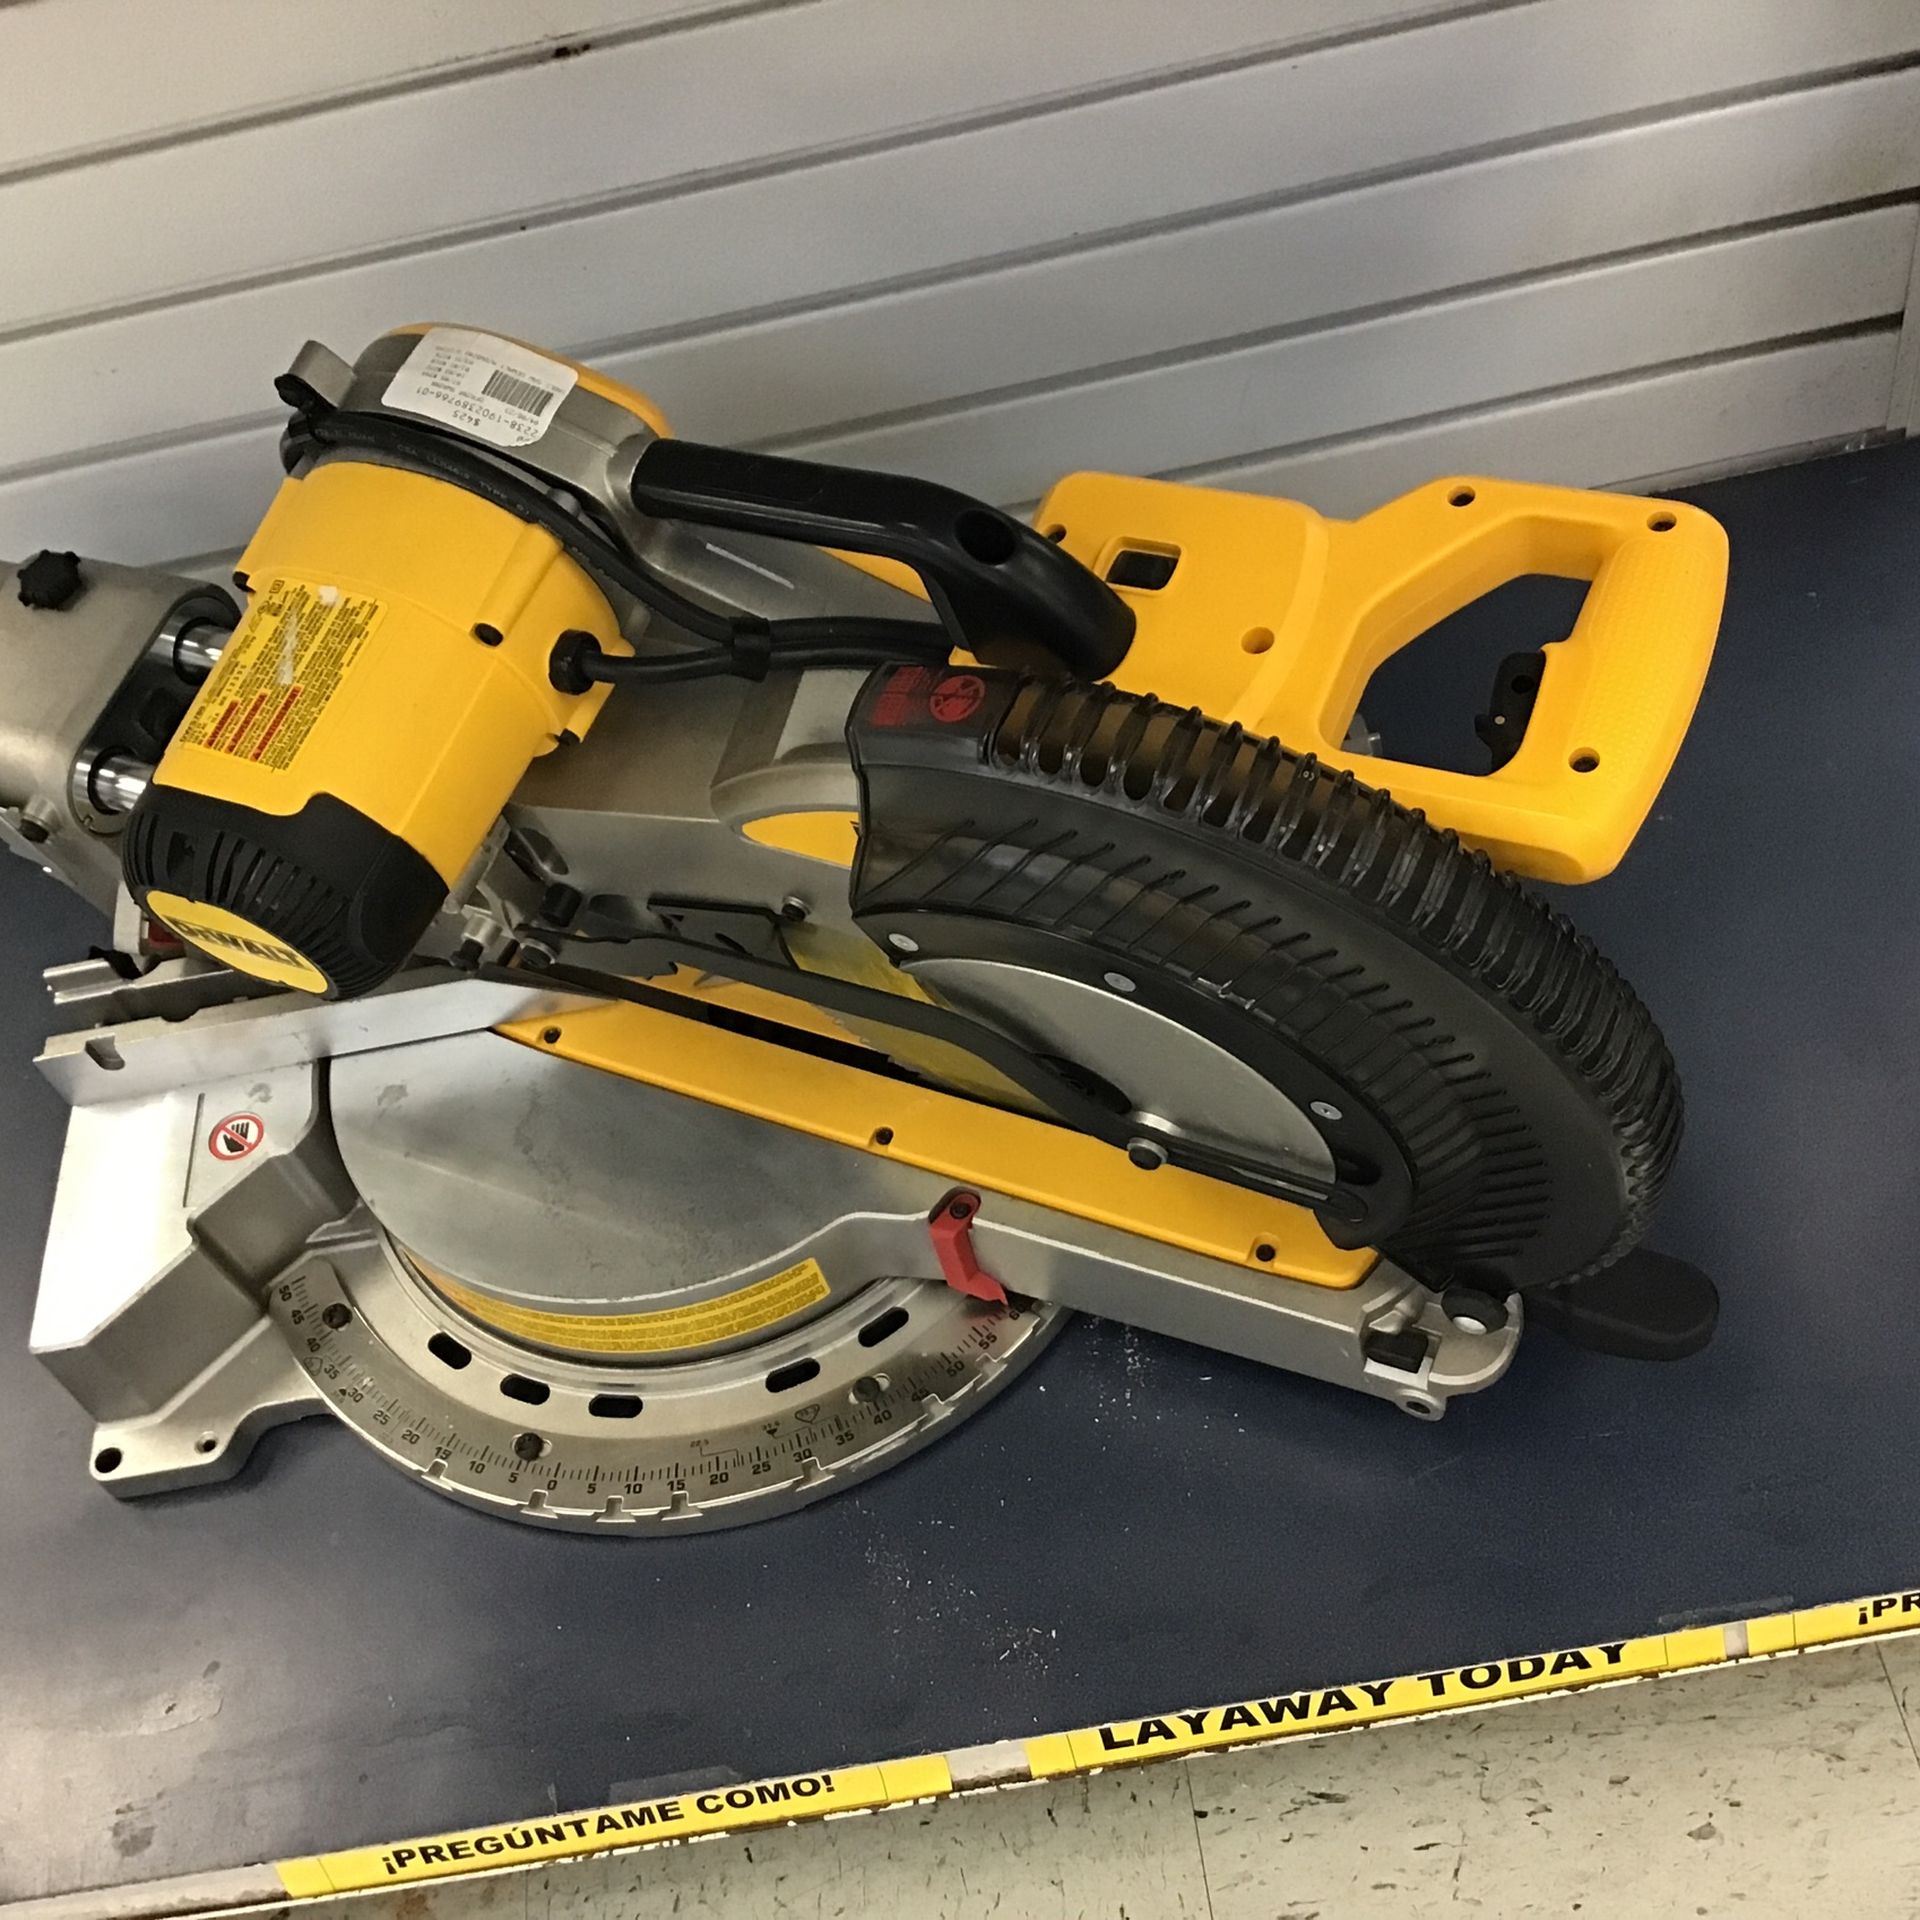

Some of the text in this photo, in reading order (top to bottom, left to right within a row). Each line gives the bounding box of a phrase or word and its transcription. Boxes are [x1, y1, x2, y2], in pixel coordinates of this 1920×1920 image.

[453, 409, 480, 427] $425
[279, 1285, 292, 1302] 50
[291, 1309, 305, 1325] 45
[306, 1337, 321, 1353] 40
[323, 1364, 340, 1380] 35
[347, 1387, 364, 1403] 30
[372, 1409, 391, 1425] 25
[401, 1429, 420, 1445] 20
[434, 1446, 452, 1460] 15
[469, 1460, 486, 1474] 10
[508, 1472, 519, 1484] 5
[547, 1479, 557, 1491] 0
[587, 1483, 597, 1494] 5
[624, 1483, 643, 1494] 10
[667, 1479, 686, 1491] 15
[709, 1472, 729, 1485] 20
[751, 1461, 771, 1475] 25
[793, 1448, 813, 1462] 30
[835, 1432, 855, 1446] 35
[873, 1409, 892, 1426] 40
[911, 1387, 930, 1403] 45
[946, 1360, 966, 1377] 50
[978, 1332, 998, 1350] 55
[1098, 1642, 1627, 1751] LAYAWAY TODAY
[382, 1774, 836, 1875] ¡PREGÚNTAME COMO!
